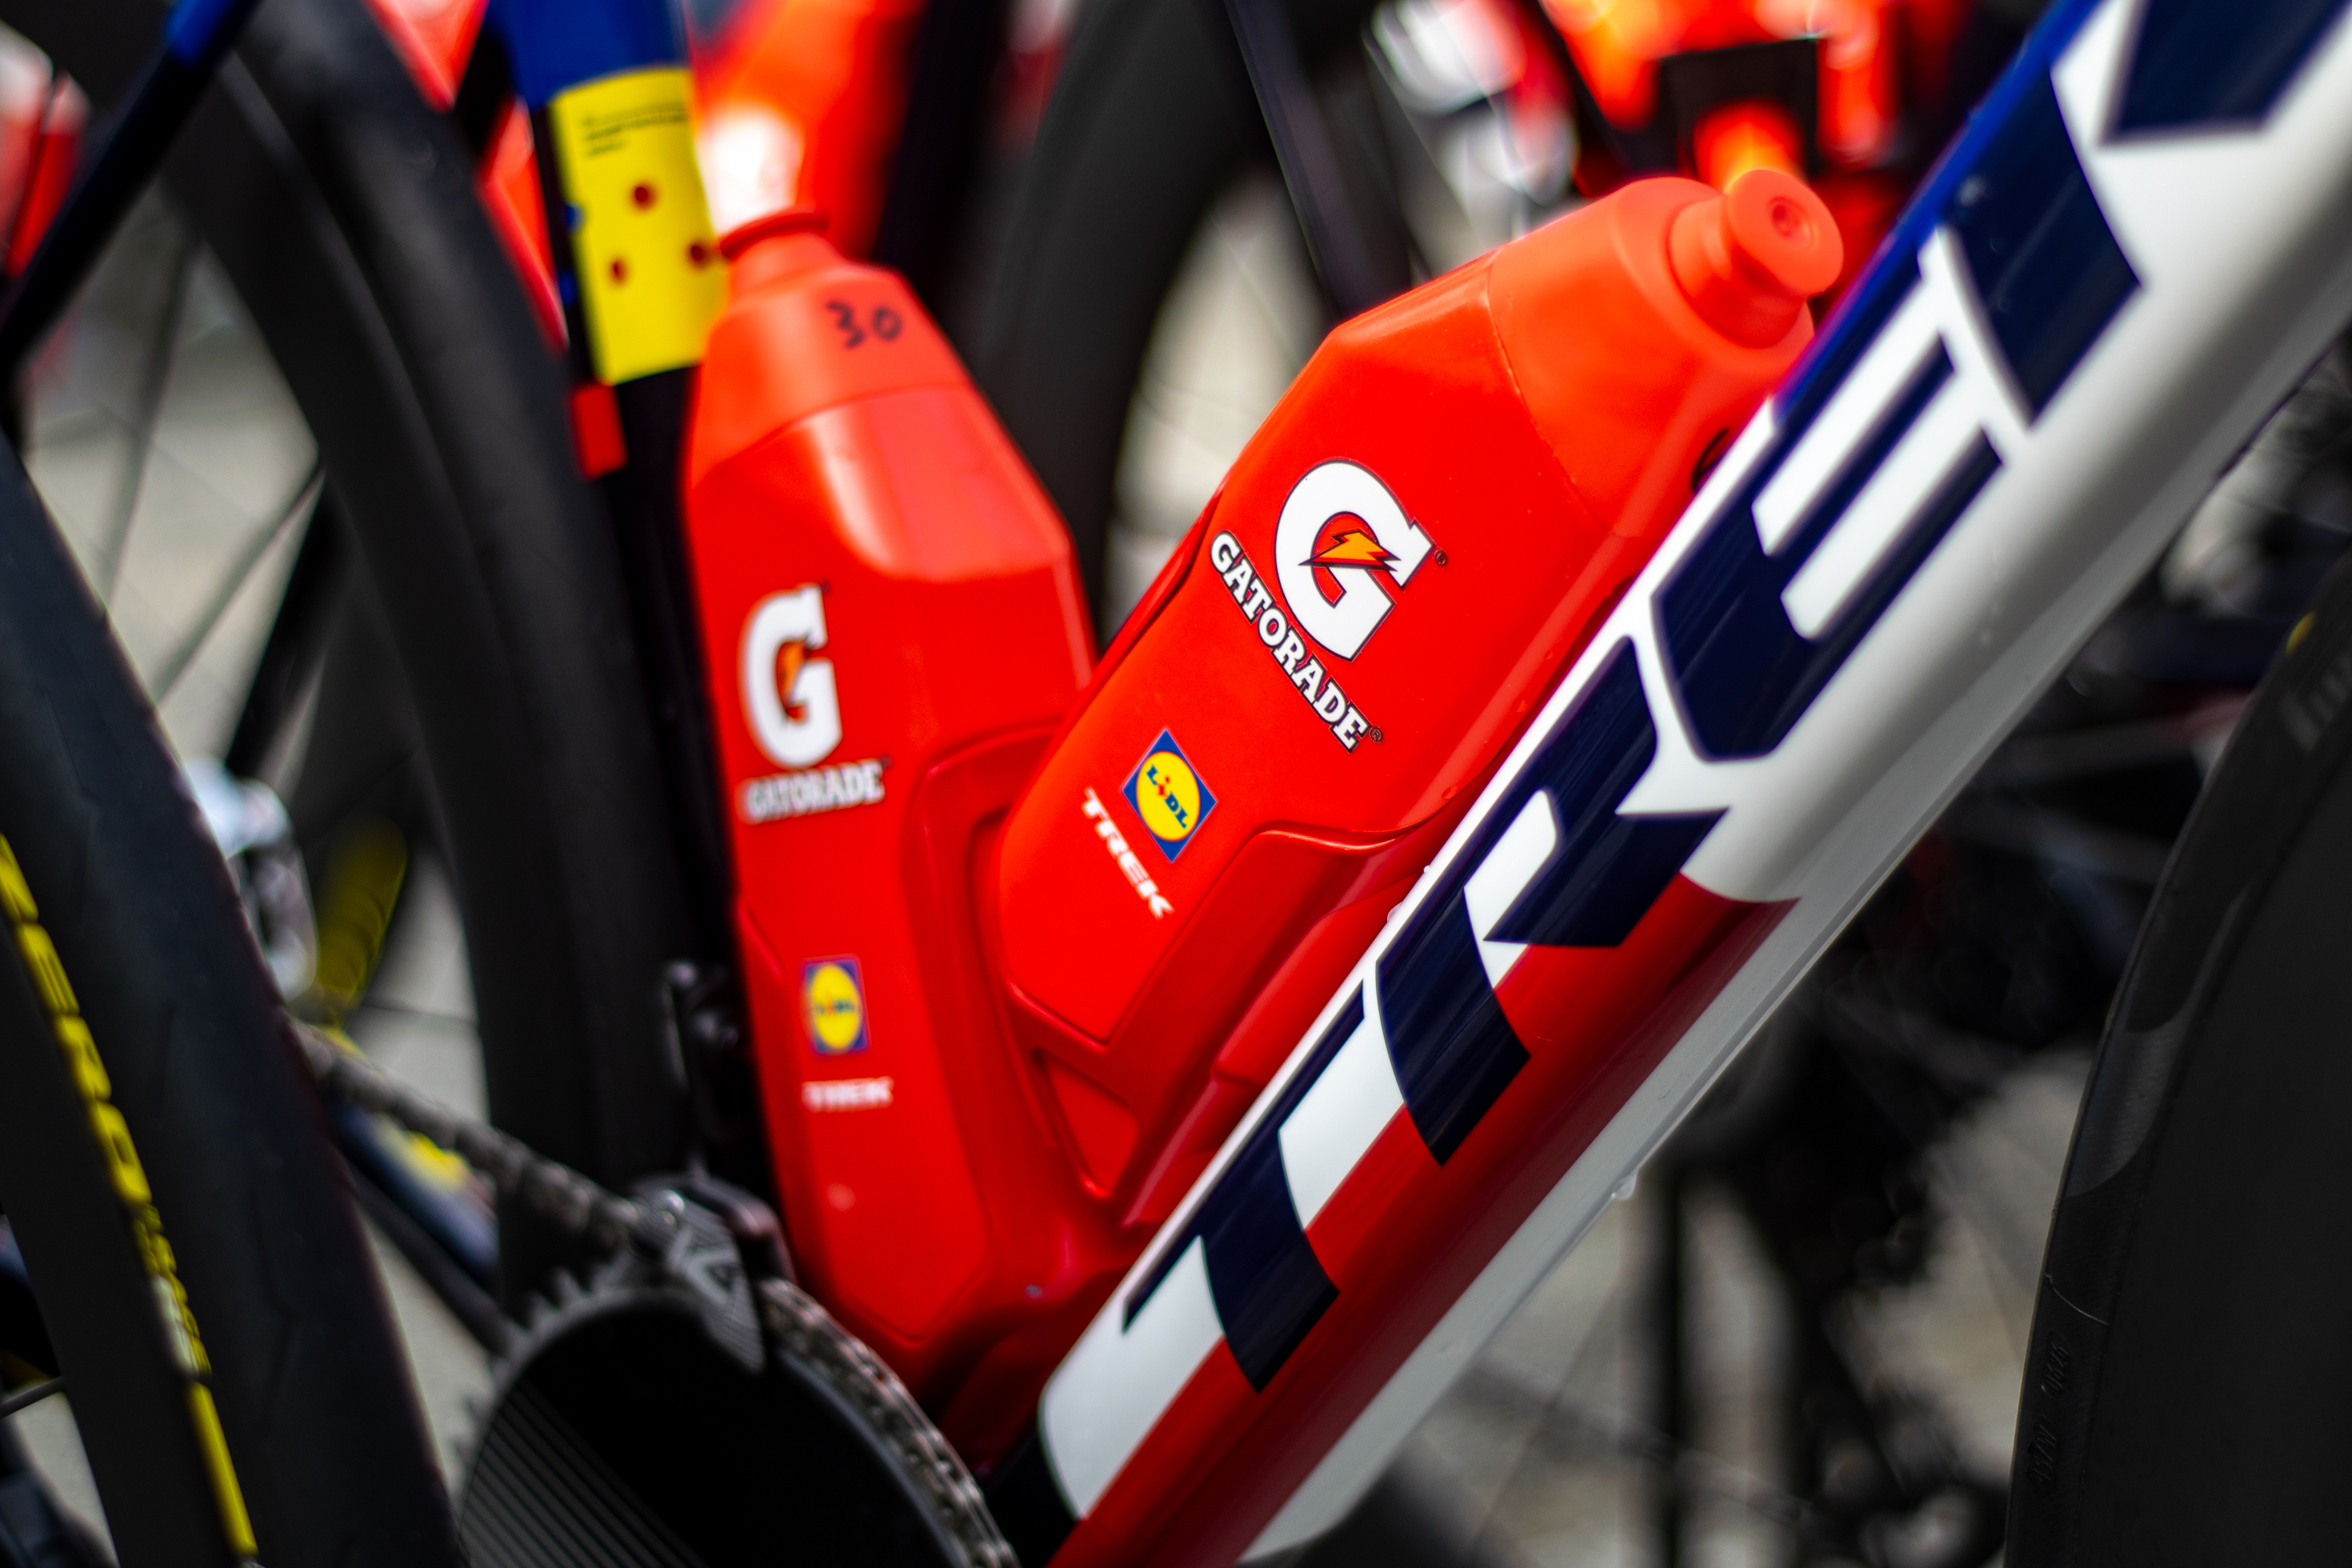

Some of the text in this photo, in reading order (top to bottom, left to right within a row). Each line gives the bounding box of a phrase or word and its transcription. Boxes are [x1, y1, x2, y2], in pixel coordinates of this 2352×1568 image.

[825, 299, 902, 350] 30
[1210, 531, 1371, 753] GATORADE
[1274, 457, 1435, 663] G
[739, 582, 844, 770] G
[1121, 0, 2350, 1394] TREK
[739, 758, 886, 823] GATORADE
[1083, 786, 1174, 920] TREK
